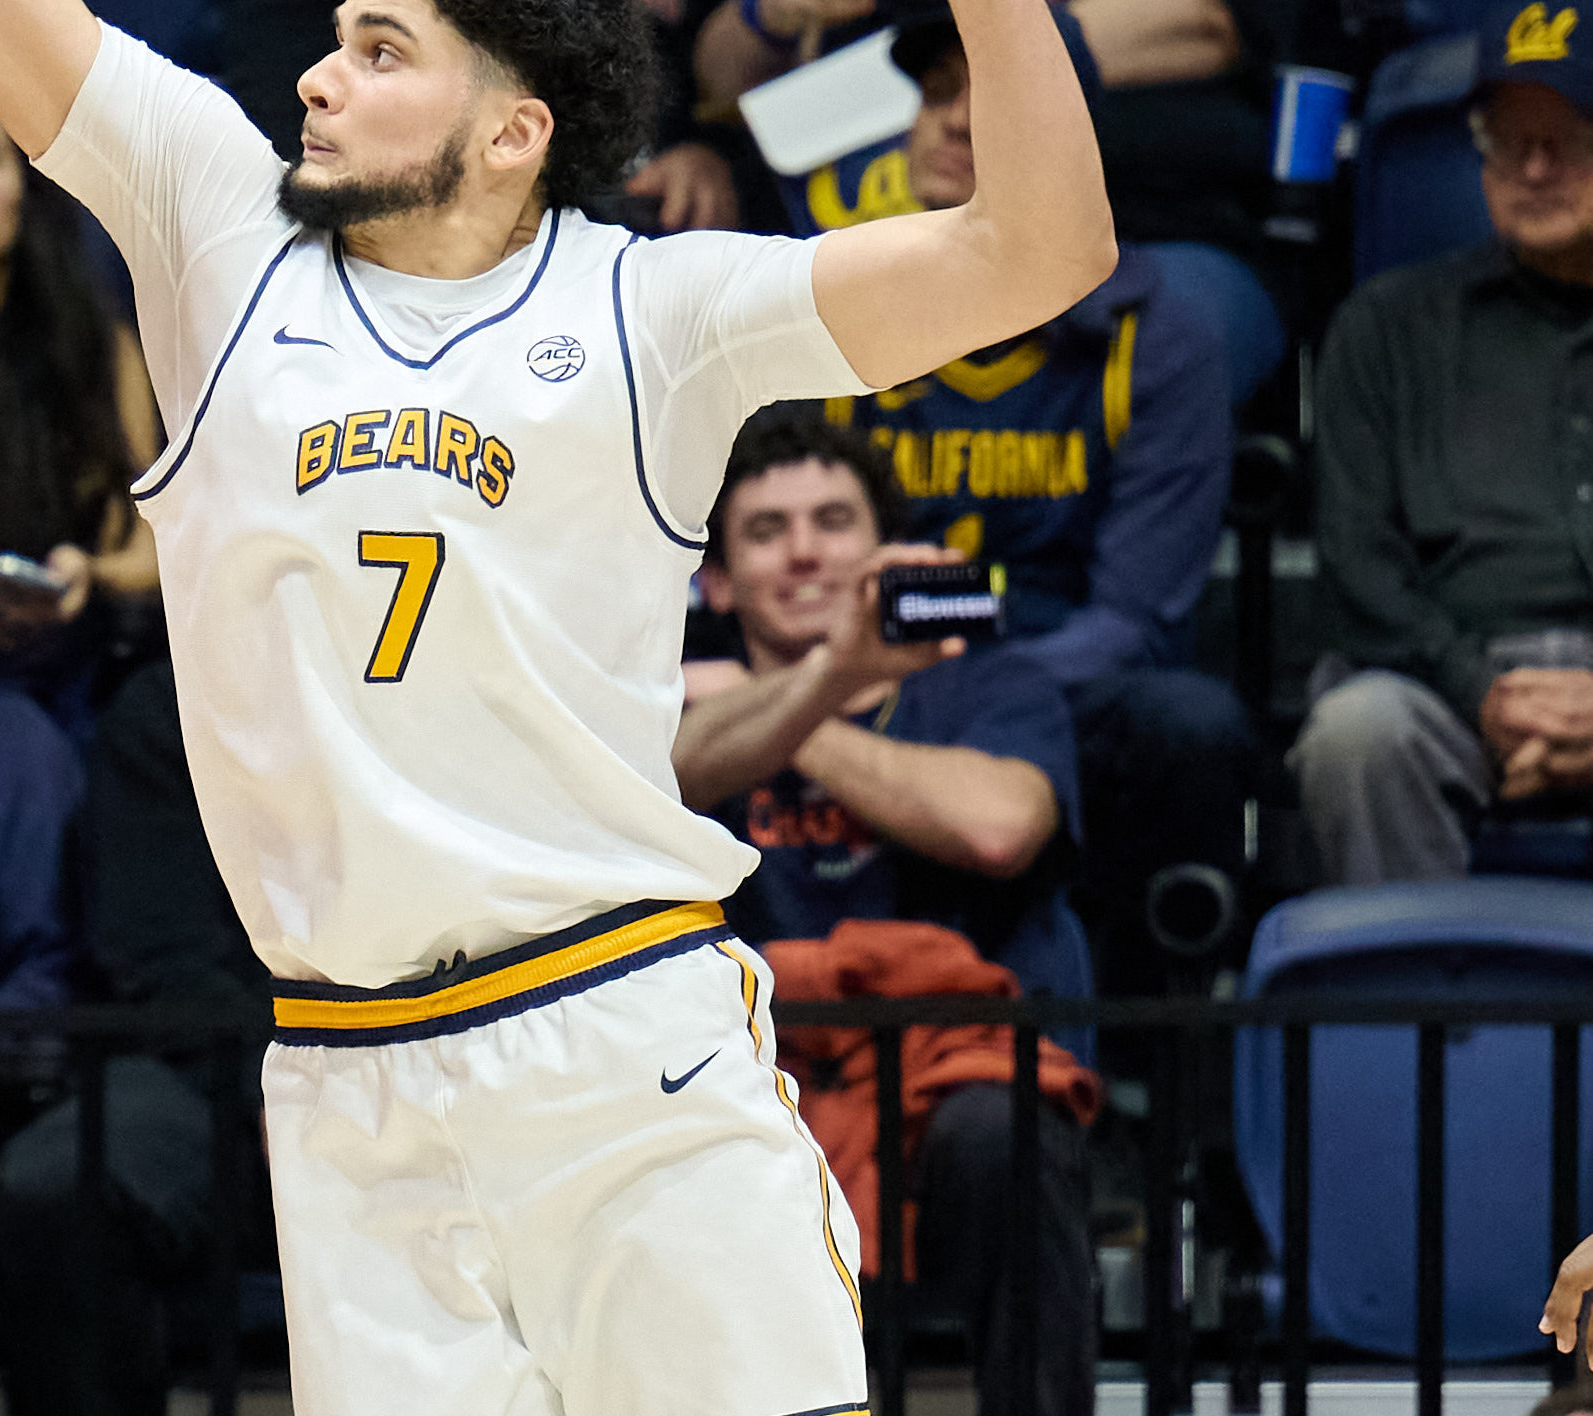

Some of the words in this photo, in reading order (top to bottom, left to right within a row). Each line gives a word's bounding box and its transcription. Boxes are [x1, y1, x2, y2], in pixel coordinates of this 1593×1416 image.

[533, 347, 582, 362] ACC
[295, 406, 516, 508] BEARS
[869, 427, 1089, 498] ALIFORNIA
[357, 530, 445, 683] 7
